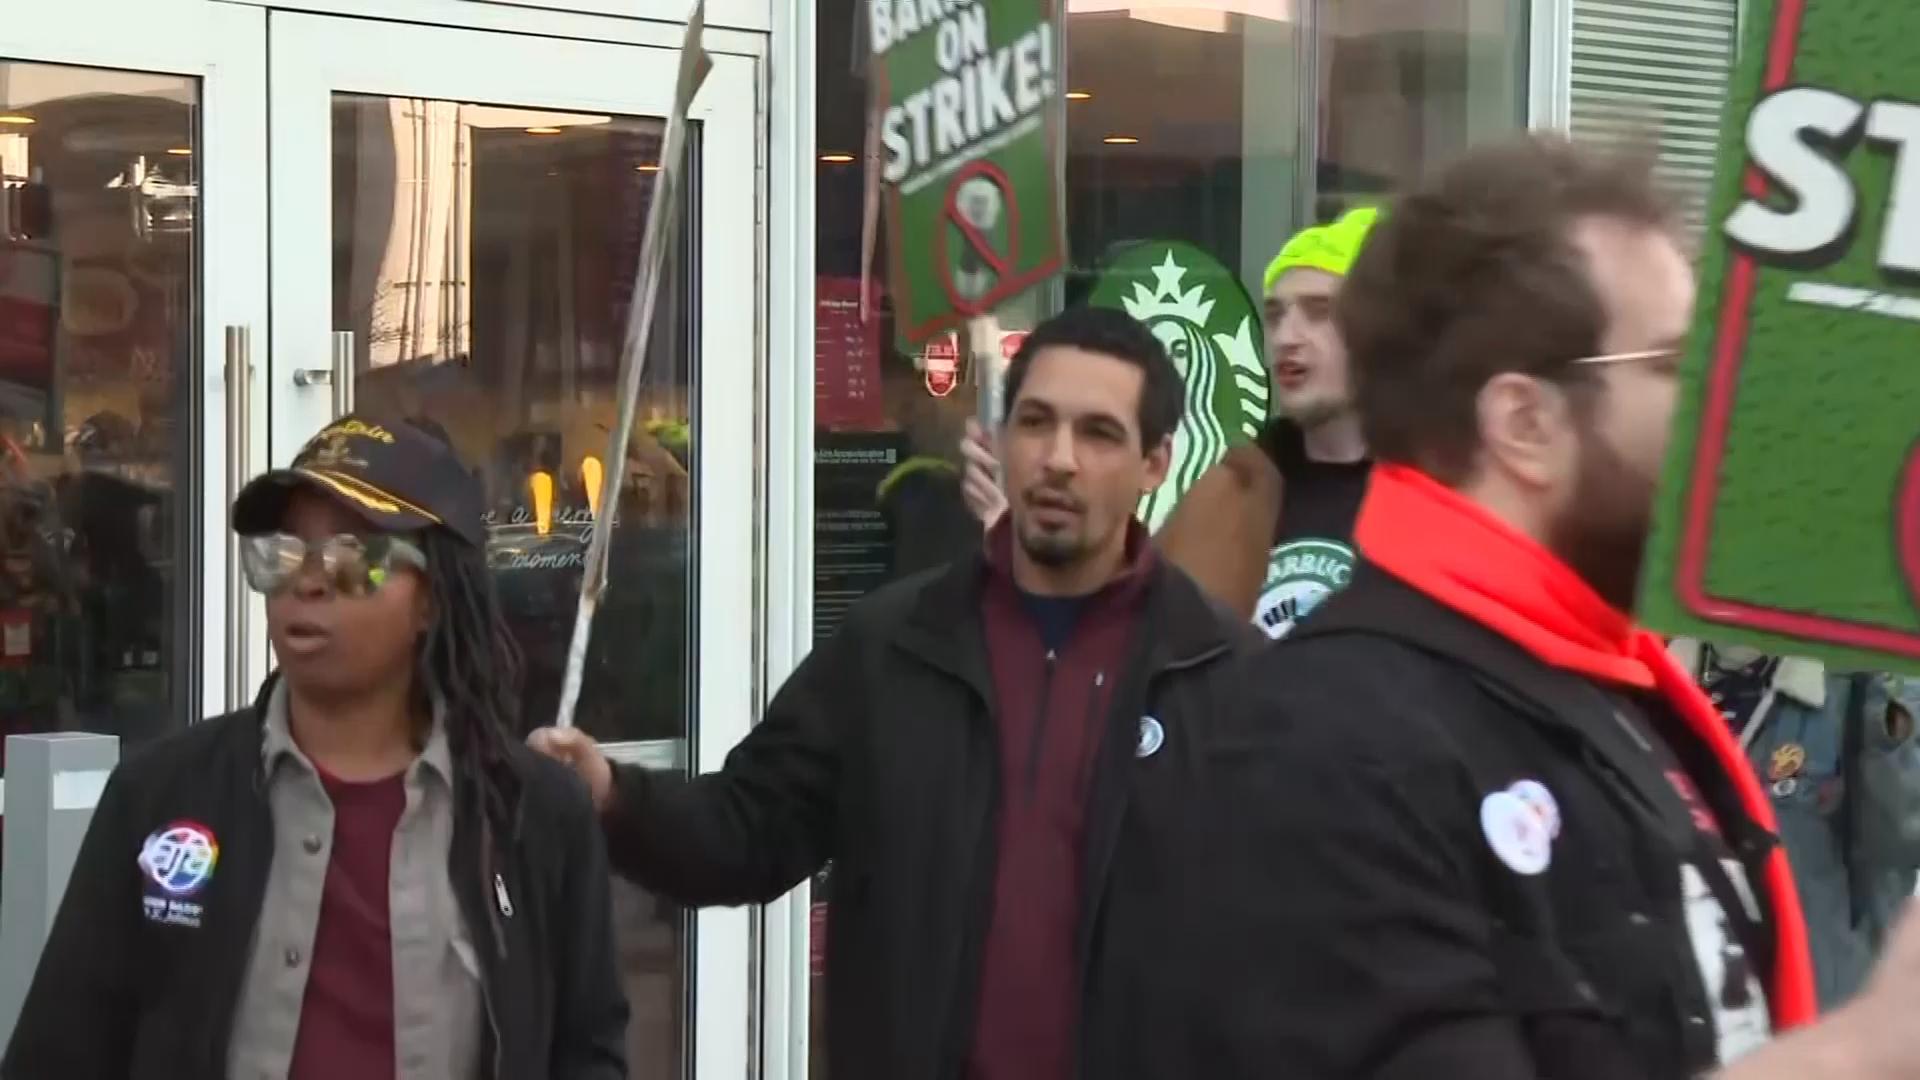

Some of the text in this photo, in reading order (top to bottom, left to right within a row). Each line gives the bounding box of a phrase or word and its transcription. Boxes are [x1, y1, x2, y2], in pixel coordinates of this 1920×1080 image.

[868, 0, 956, 54] BAR
[935, 2, 987, 72] ON
[881, 22, 1056, 182] STRIKE!
